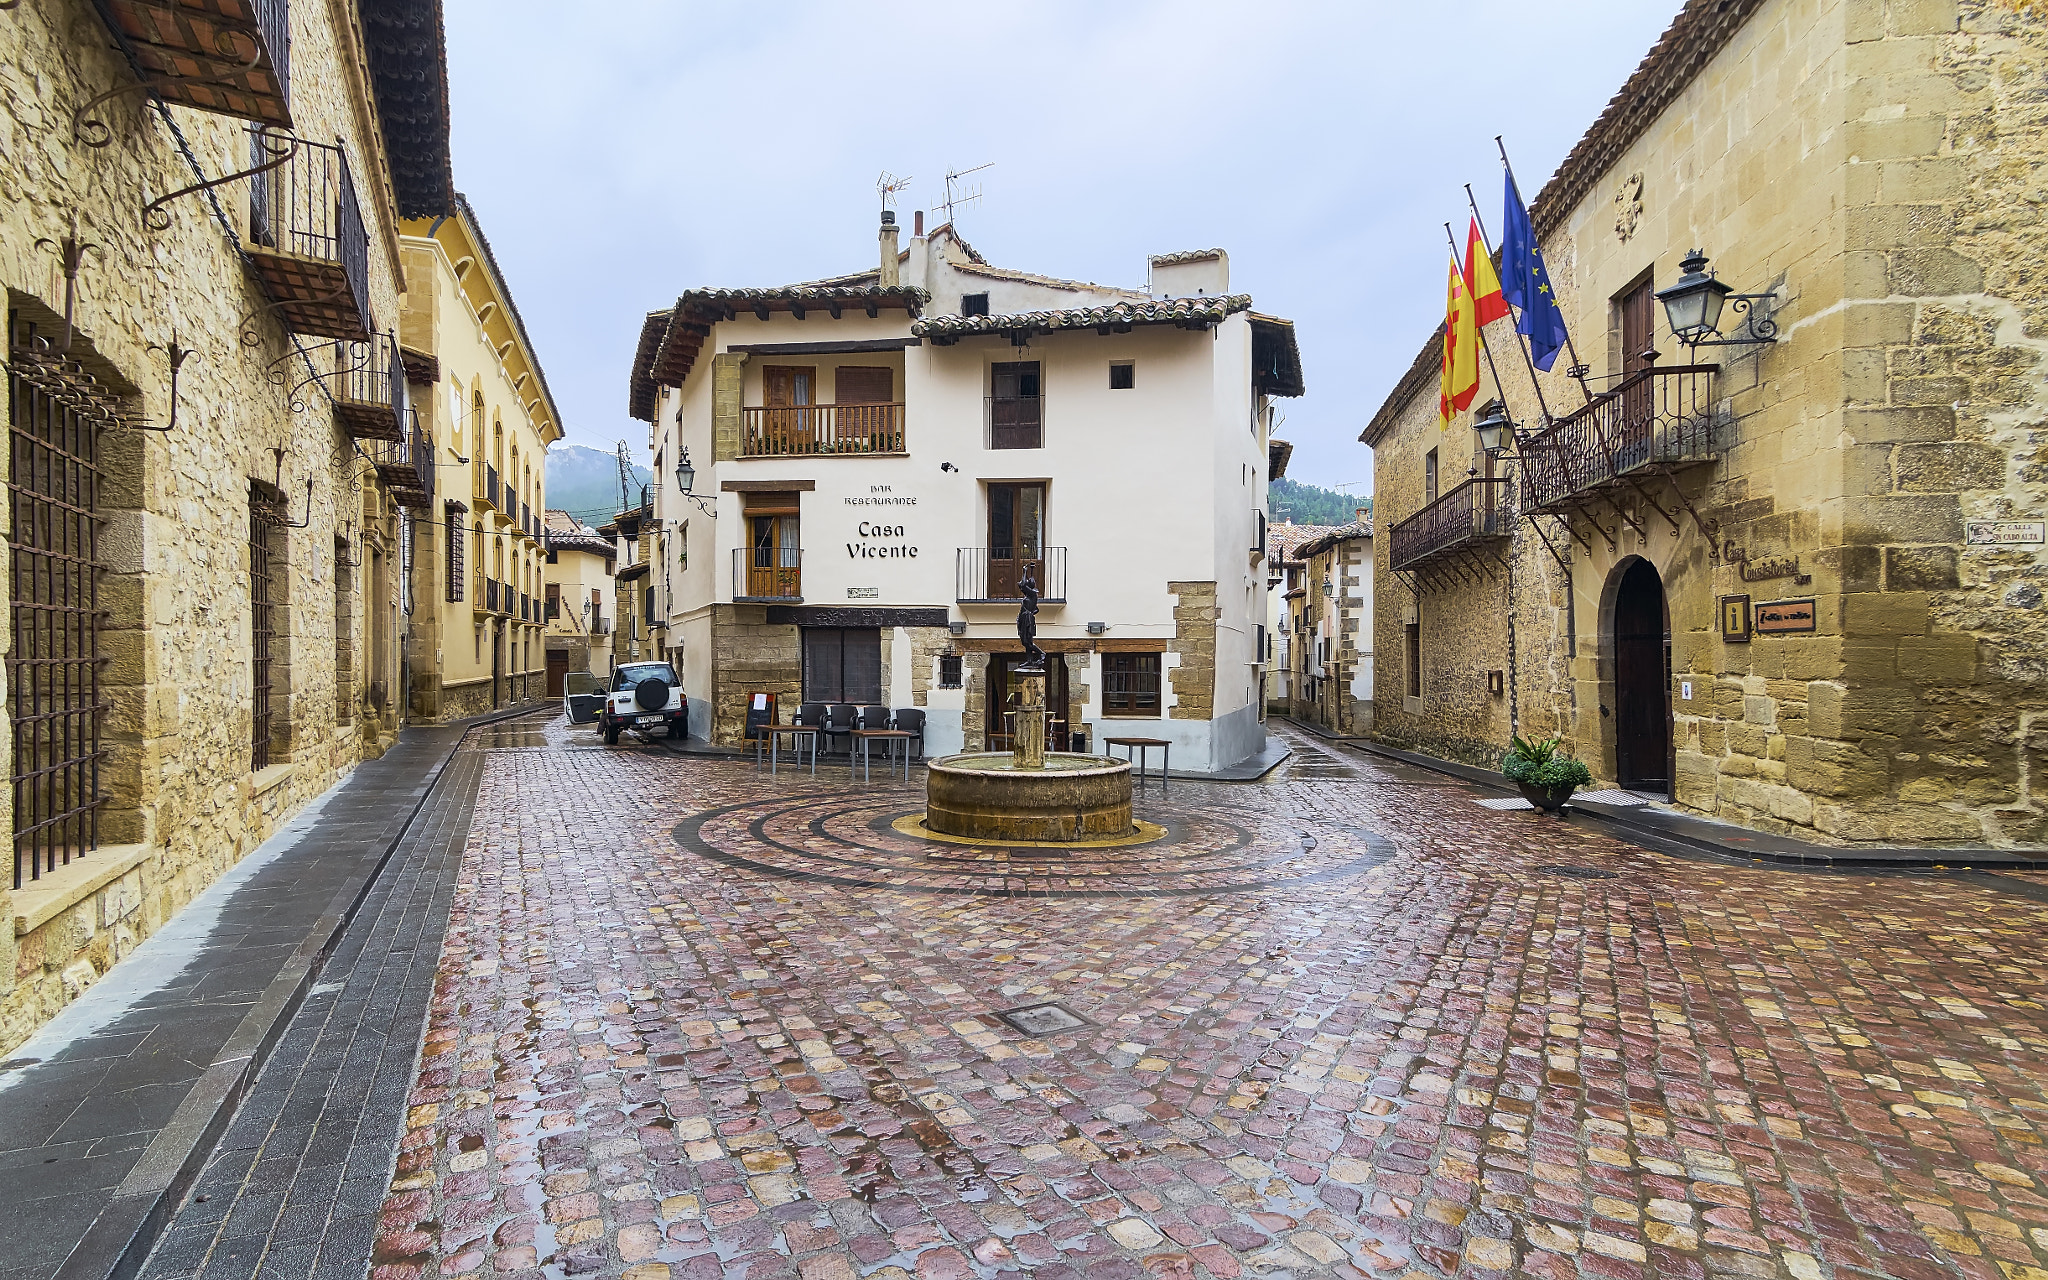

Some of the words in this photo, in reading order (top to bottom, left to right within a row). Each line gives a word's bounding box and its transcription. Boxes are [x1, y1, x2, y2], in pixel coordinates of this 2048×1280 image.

[870, 485, 892, 493] BAR
[844, 497, 917, 505] RESTAURANTE
[858, 521, 904, 537] Casa
[847, 542, 918, 558] Vicente
[1723, 540, 1745, 562] Casa
